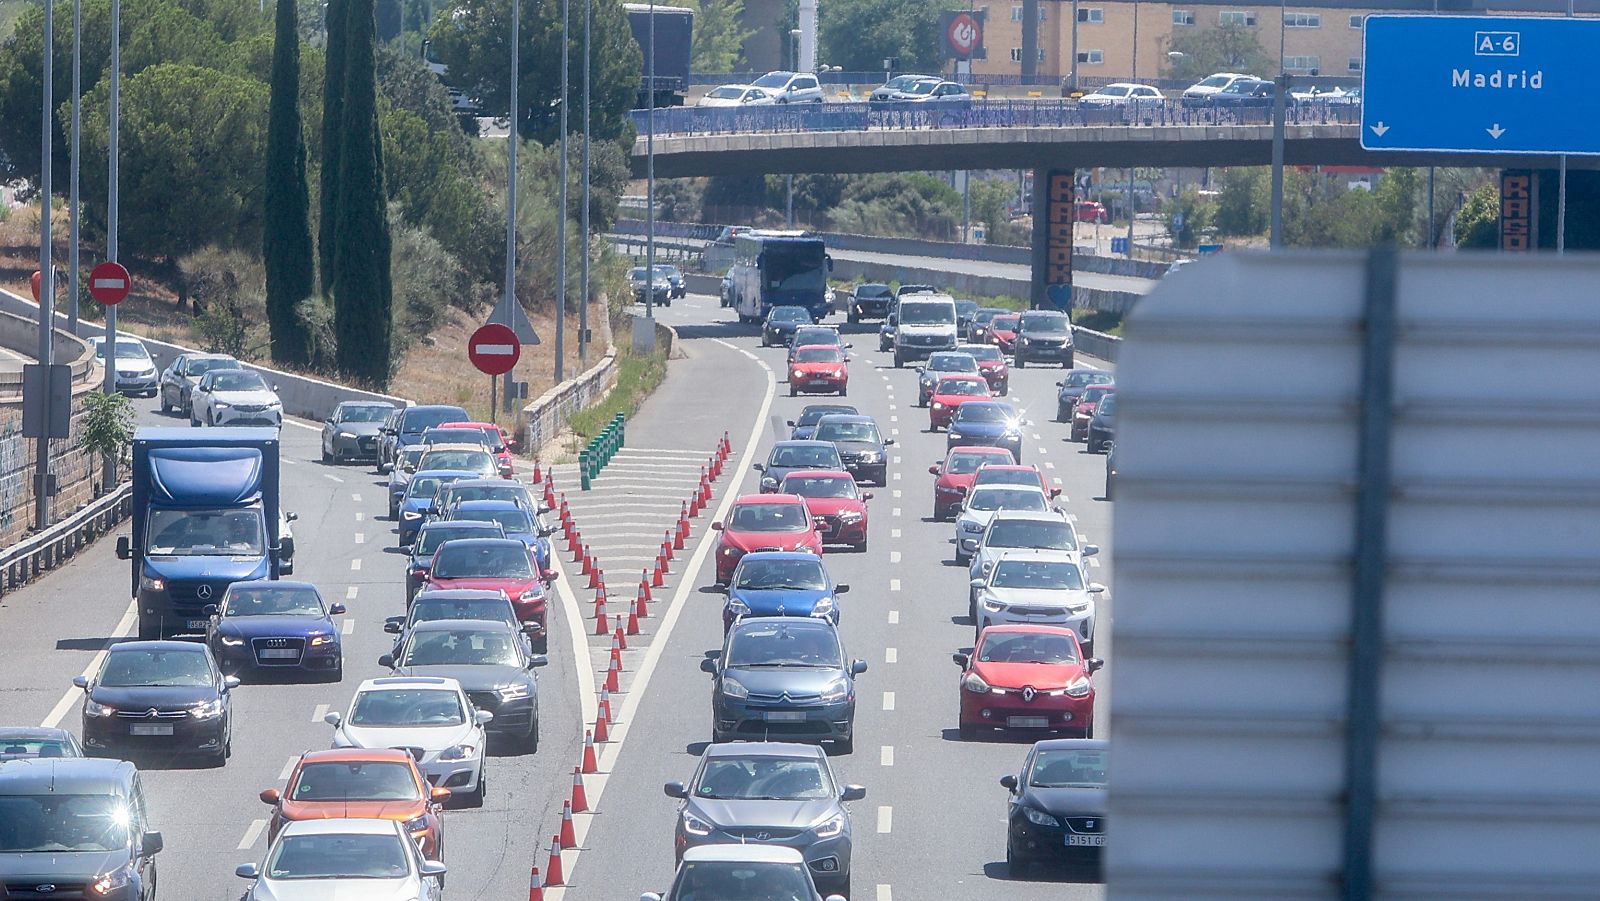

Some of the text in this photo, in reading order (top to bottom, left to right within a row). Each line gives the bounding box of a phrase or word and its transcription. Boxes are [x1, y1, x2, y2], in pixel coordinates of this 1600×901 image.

[1480, 36, 1515, 51] A-6
[1452, 69, 1542, 88] Madrid
[1070, 836, 1091, 845] 5151
